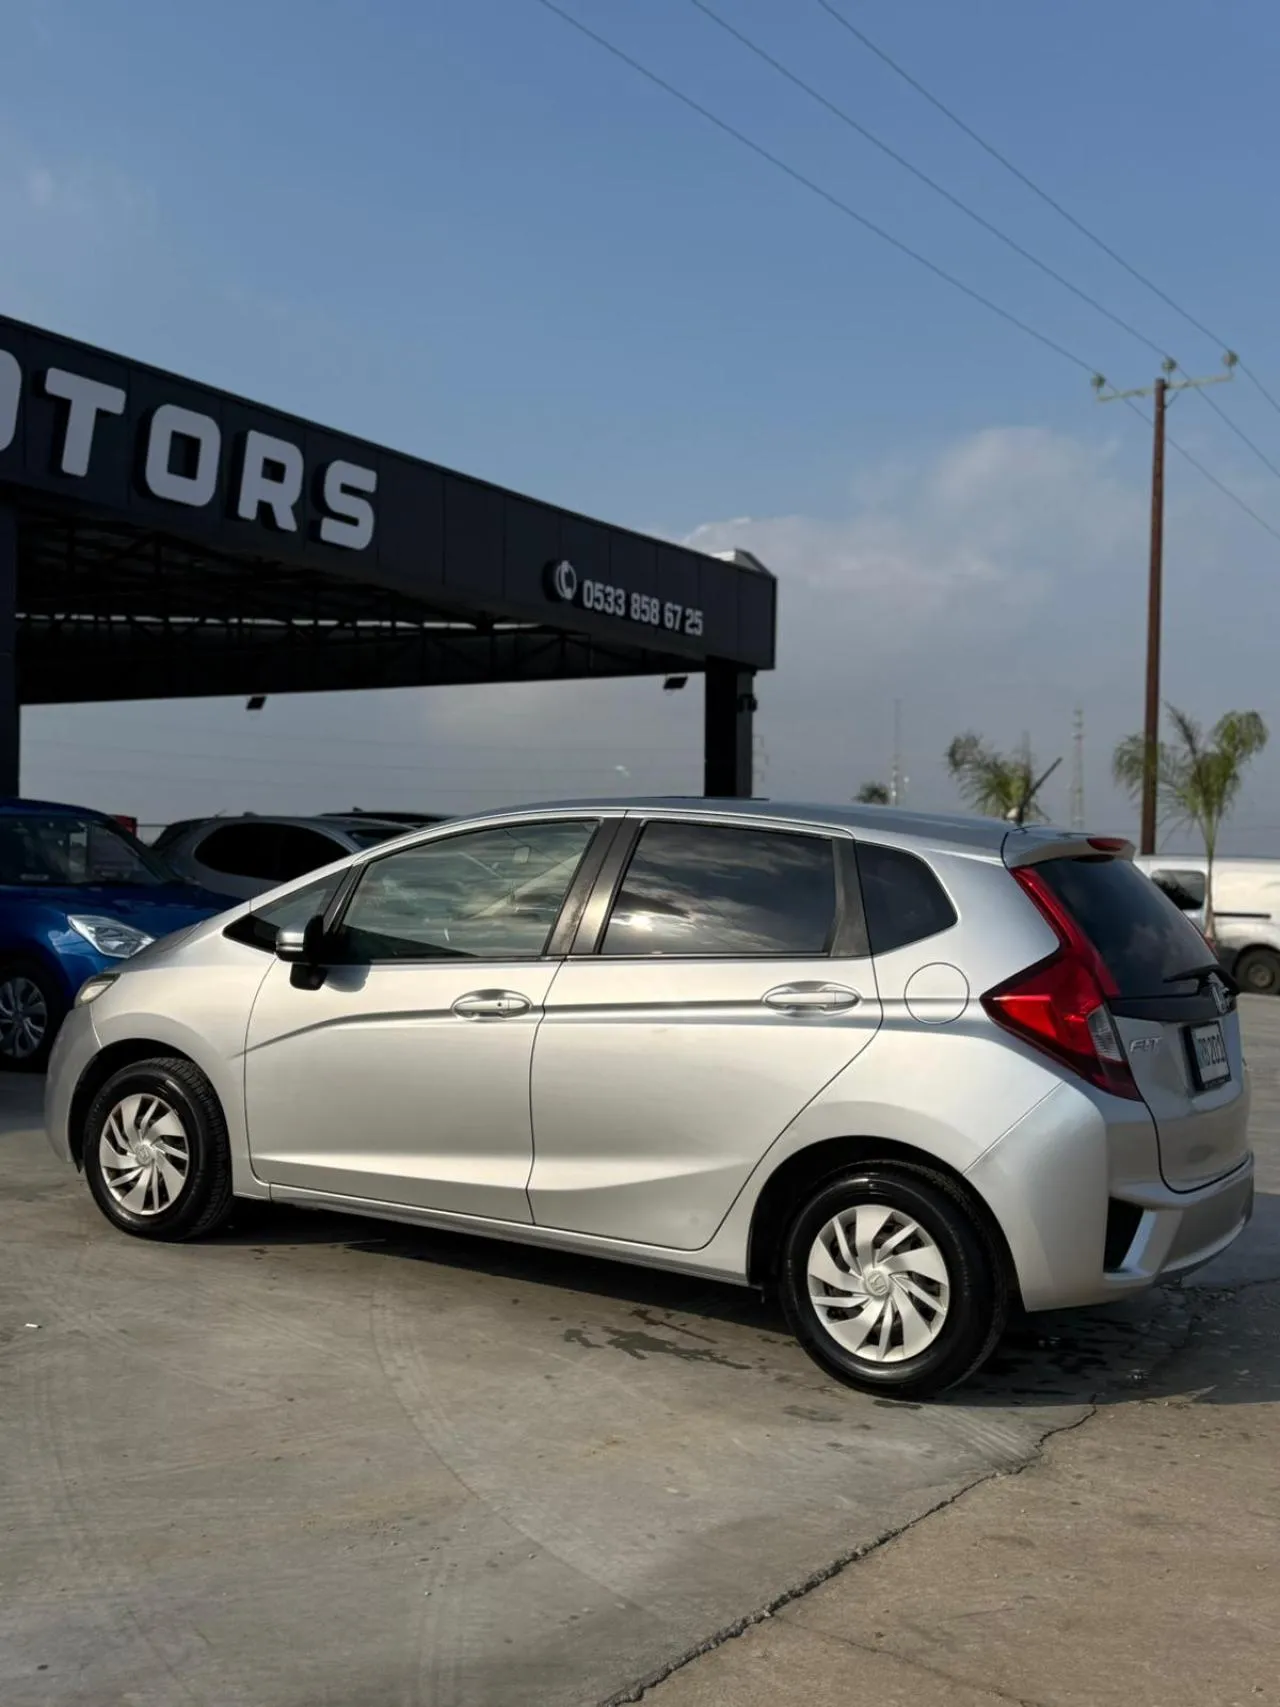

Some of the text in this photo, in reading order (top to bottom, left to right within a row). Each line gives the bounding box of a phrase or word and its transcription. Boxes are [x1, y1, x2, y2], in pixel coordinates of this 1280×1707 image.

[0, 349, 378, 551] TORS
[583, 579, 704, 636] 0533 858 67 25
[1130, 1036, 1163, 1052] FIT
